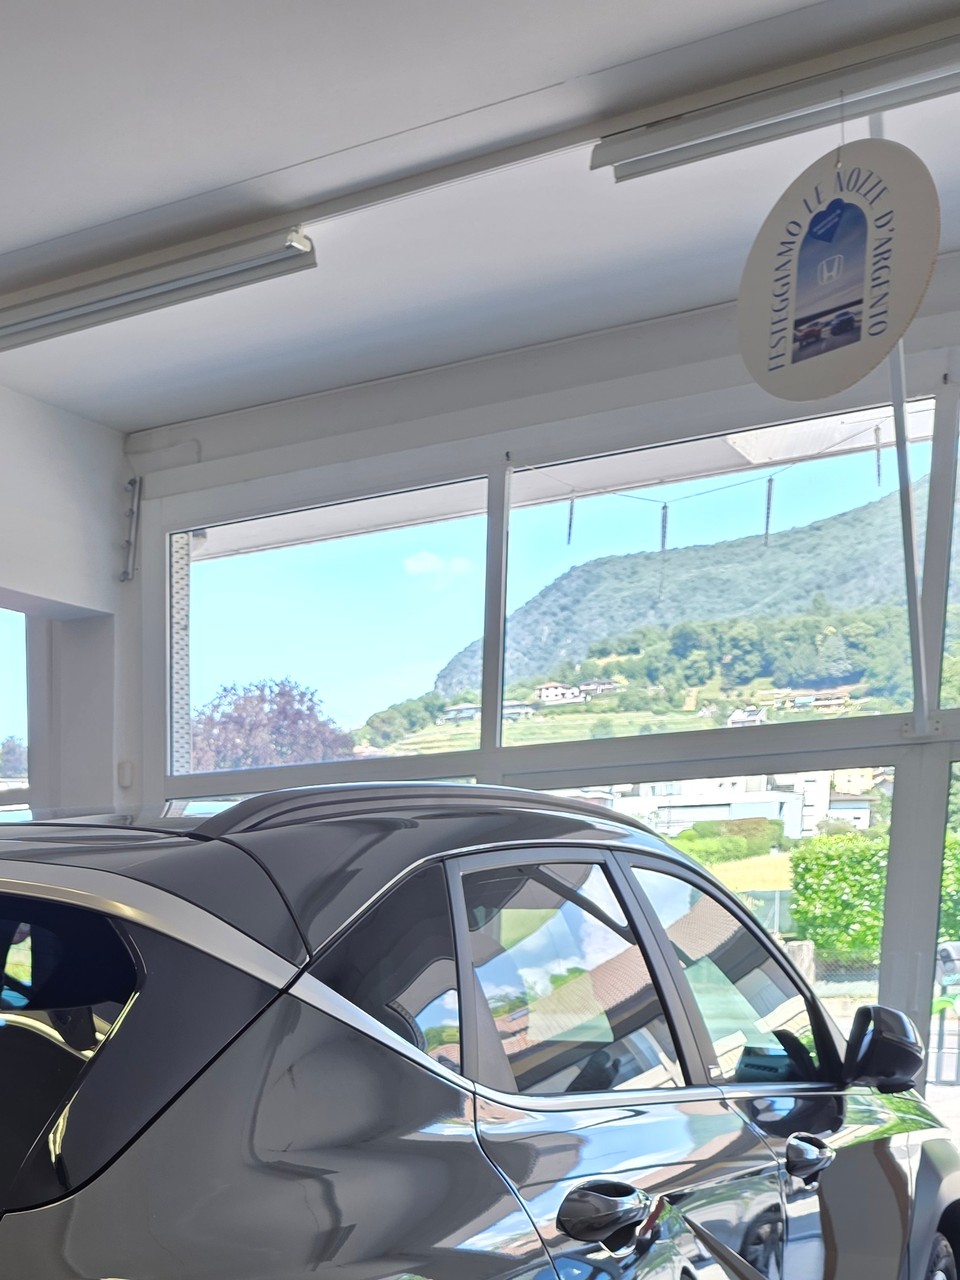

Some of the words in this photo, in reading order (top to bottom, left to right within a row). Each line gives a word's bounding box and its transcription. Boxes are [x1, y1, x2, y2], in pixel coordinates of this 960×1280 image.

[768, 220, 802, 371] FESTEGGIAMO
[803, 181, 826, 214] LE
[833, 167, 888, 211] NOZZE
